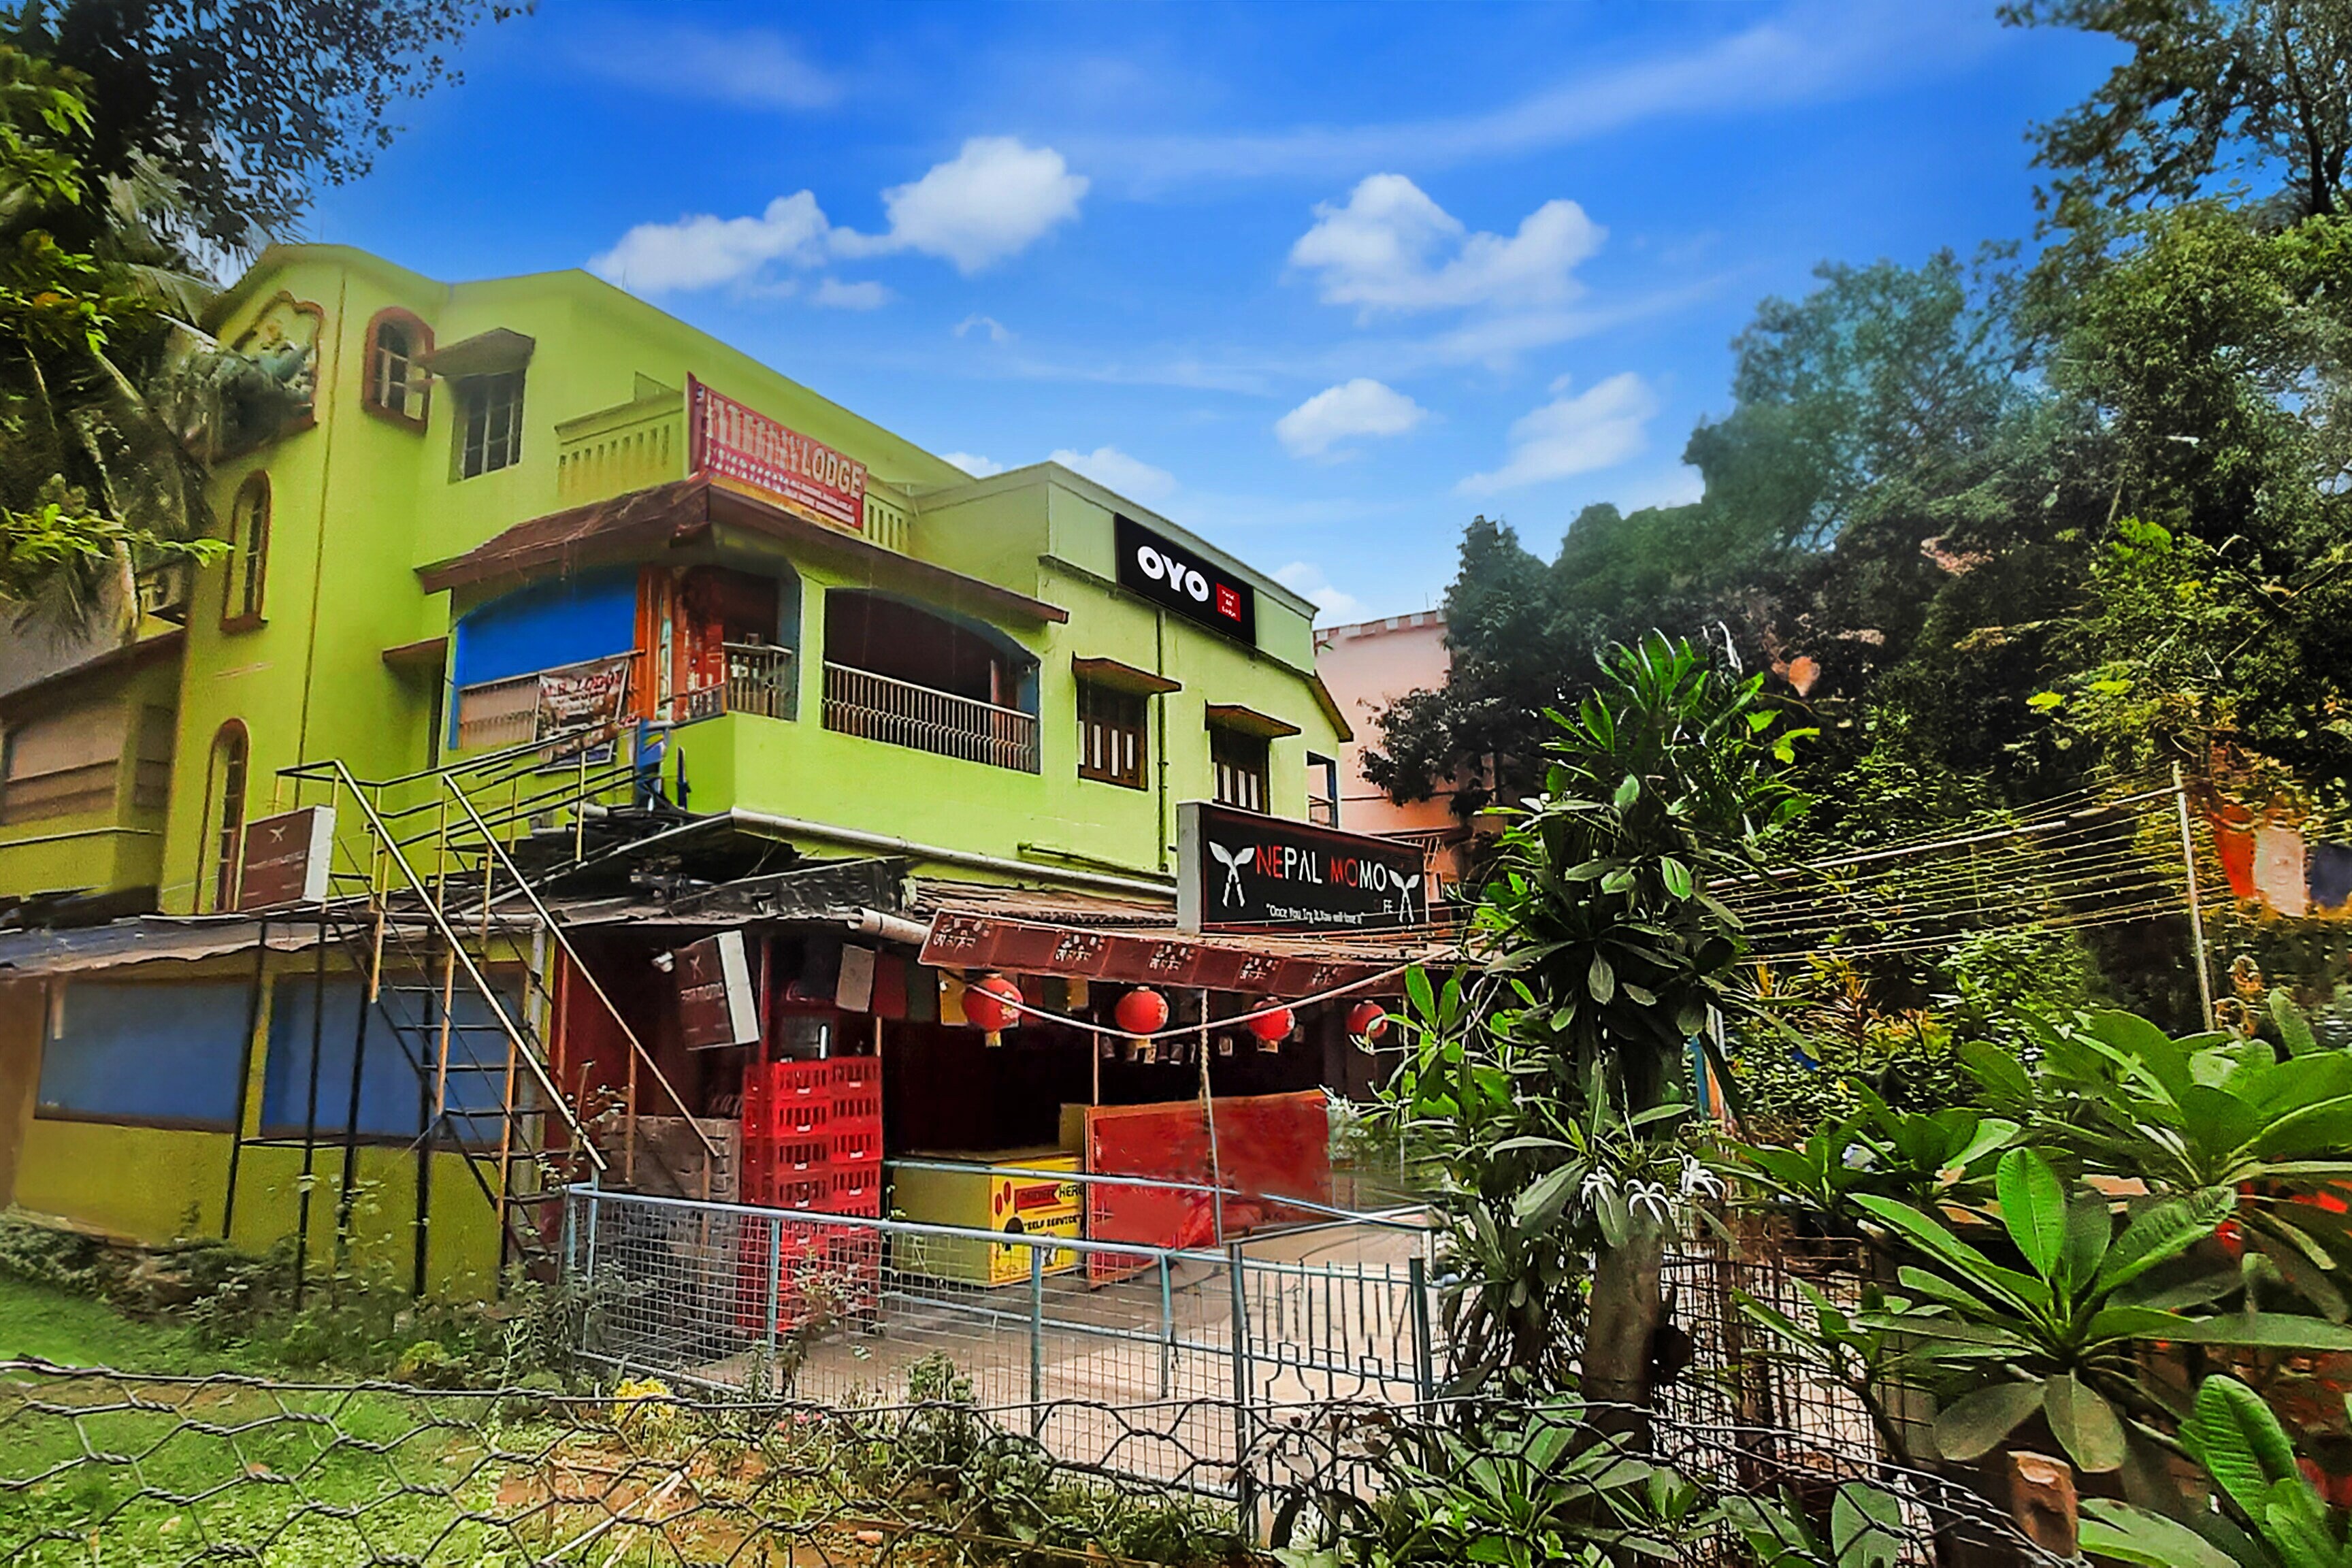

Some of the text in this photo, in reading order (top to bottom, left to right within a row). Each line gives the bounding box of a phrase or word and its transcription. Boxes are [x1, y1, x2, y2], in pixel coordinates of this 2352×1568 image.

[802, 442, 863, 499] LODGE
[1137, 546, 1209, 602] OYO
[1256, 845, 1387, 892] NEPAL MOMO
